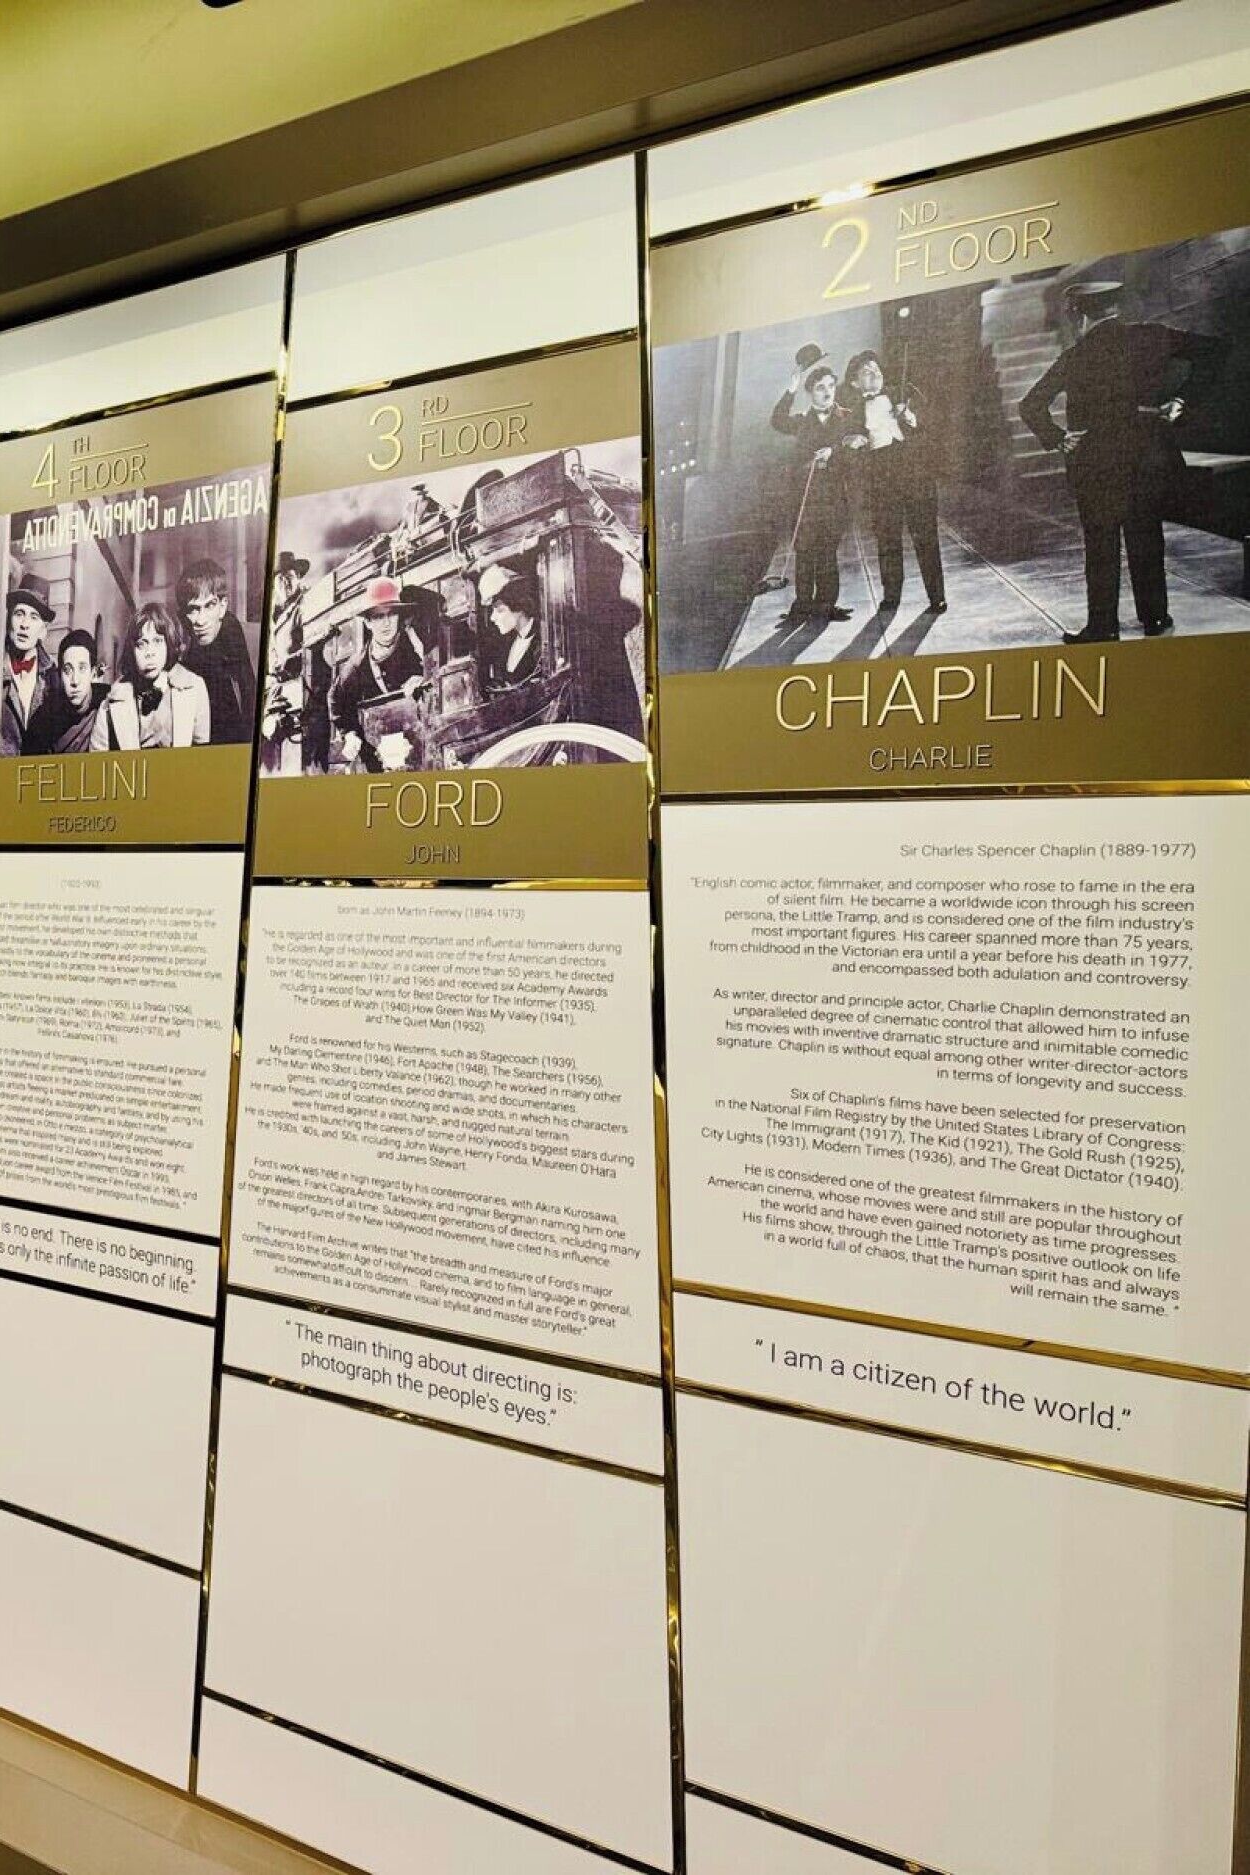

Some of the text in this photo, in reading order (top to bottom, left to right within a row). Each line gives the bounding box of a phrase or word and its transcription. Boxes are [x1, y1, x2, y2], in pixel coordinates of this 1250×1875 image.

[900, 200, 939, 229] ND
[821, 217, 1053, 299] 2 FLOOR
[422, 396, 449, 417] RD
[368, 404, 527, 471] 3 FLOOR
[31, 442, 147, 498] 4 FLOOR
[775, 655, 1106, 732] CHAPLIN
[17, 758, 148, 804] FELLINI
[869, 744, 993, 772] CHARLIE
[49, 816, 117, 834] FEDERICO
[366, 779, 503, 829] FORD
[405, 844, 461, 865] JOHN
[899, 840, 1196, 859] Sir Charles Spencer Chaplin (1889-1977)
[790, 1087, 1186, 1135] Six of Chaplin's films have been selected for preservation
[376, 1150, 394, 1160] and
[395, 1151, 427, 1165] James
[701, 1126, 724, 1142] City
[726, 1128, 763, 1144] Lights
[811, 1137, 861, 1154] Modern
[864, 1143, 905, 1159] Times
[958, 1155, 986, 1168] and
[989, 1156, 1017, 1171] The
[1019, 1160, 1060, 1176] Great
[1063, 1164, 1125, 1183] Dictator
[744, 1163, 1183, 1228] He is considered one of the greatest filmmakers in the history of
[2, 1221, 11, 1234] is
[14, 1224, 28, 1237] no
[61, 1230, 93, 1250] There
[97, 1241, 106, 1253] is
[110, 1244, 126, 1257] no
[8, 1243, 32, 1261] only
[34, 1248, 51, 1263] the
[56, 1253, 95, 1272] infinite
[100, 1262, 148, 1284] passion
[152, 1273, 166, 1286] of
[296, 1322, 576, 1404] The main thing about directing is:
[301, 1350, 392, 1386] photograph
[398, 1372, 422, 1392] the
[428, 1382, 498, 1413] people's
[771, 1343, 775, 1363] I
[784, 1349, 822, 1371] am
[831, 1358, 844, 1376] a
[853, 1361, 935, 1393] citizen
[946, 1378, 972, 1400] of
[981, 1383, 1024, 1411] the
